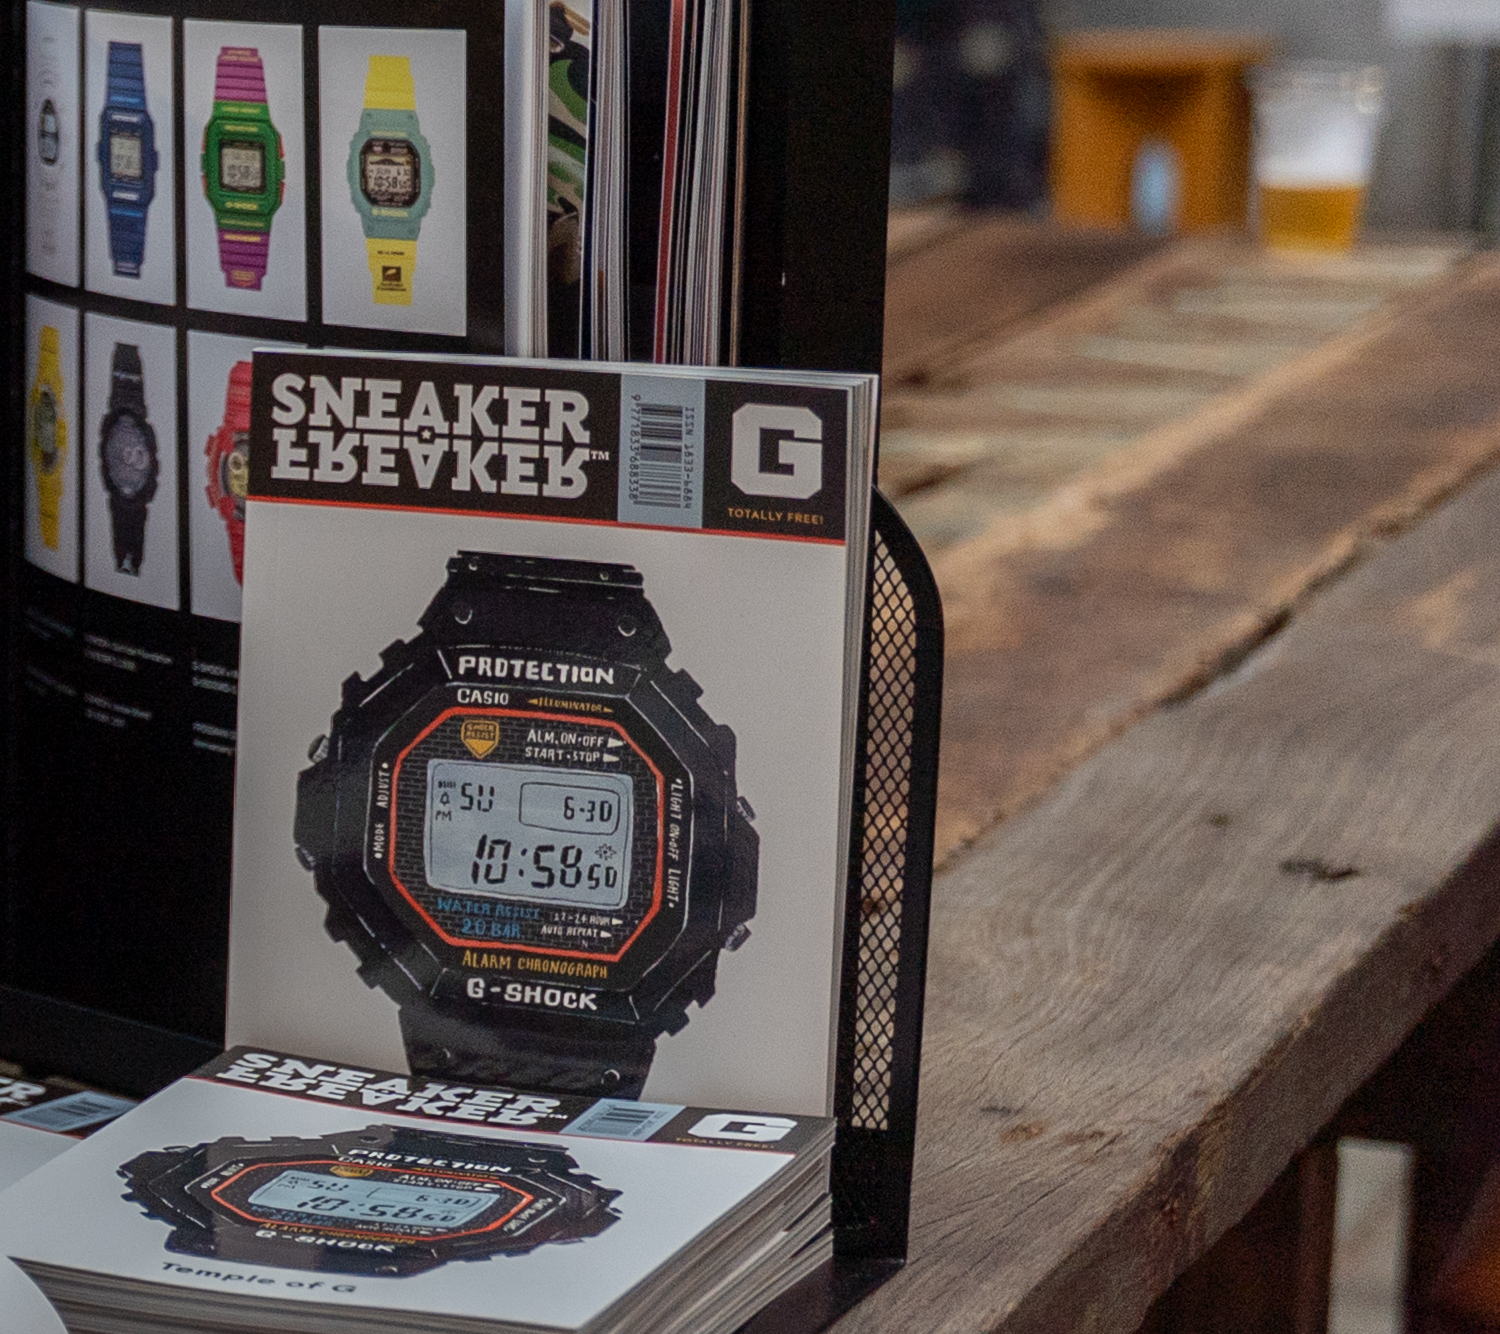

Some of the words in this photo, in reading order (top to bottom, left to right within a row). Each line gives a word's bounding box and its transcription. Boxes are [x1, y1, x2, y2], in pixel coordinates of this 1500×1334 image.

[272, 373, 591, 444] SNEAKER
[730, 402, 823, 500] G
[728, 507, 783, 522] TOTALLY
[787, 512, 824, 525] FREE!
[457, 655, 615, 685] PROTECTION
[457, 688, 510, 706] CASIO
[376, 771, 391, 809] ADJUST
[668, 782, 683, 819] LIGHT
[373, 822, 386, 854] MODE
[471, 833, 583, 889] 10:58
[666, 868, 682, 904] LIGHT
[437, 896, 490, 915] WATER
[461, 917, 487, 936] 20
[490, 920, 521, 938] BAR
[541, 924, 564, 936] AUTO
[462, 949, 512, 970] ALARM
[517, 956, 609, 980] CHRONOGRAPH
[466, 977, 598, 1011] G-SHOCK
[229, 1052, 563, 1114] SNEAKER
[687, 1113, 798, 1143] G
[348, 1148, 512, 1174] PROTECTION
[255, 1230, 397, 1253] G-SHOCK
[162, 1261, 275, 1285] Temple
[285, 1281, 326, 1290] of
[332, 1284, 357, 1294] G
